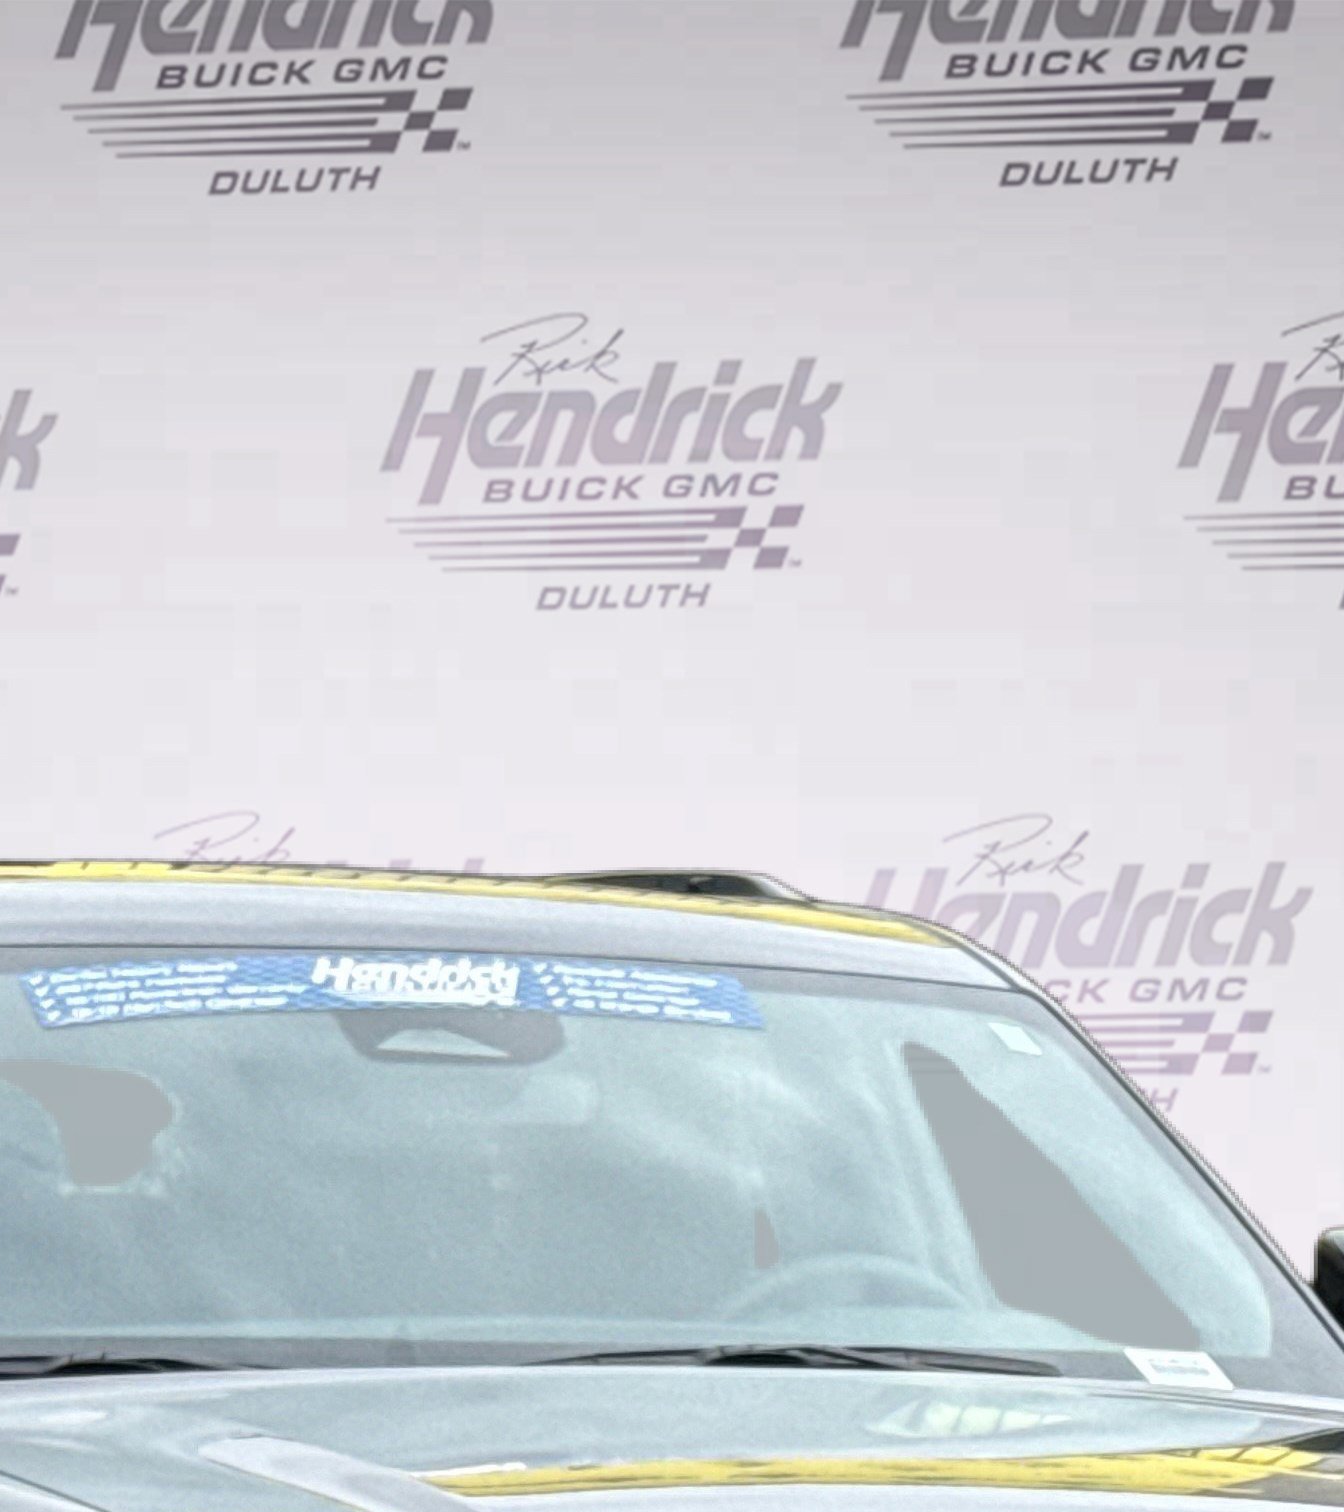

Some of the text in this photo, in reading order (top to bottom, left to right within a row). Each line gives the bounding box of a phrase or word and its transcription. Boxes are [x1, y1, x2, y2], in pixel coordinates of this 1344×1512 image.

[154, 54, 449, 91] BUICK GMC
[944, 43, 1249, 80] BUICK GMC
[207, 165, 382, 196] DULUTH
[998, 156, 1179, 188] DULUTH
[378, 356, 844, 507] Hendrick
[481, 471, 781, 504] BUICK GMC
[534, 582, 712, 612] DULUTH
[863, 860, 1314, 968] endrick
[1128, 975, 1249, 1004] GMC
